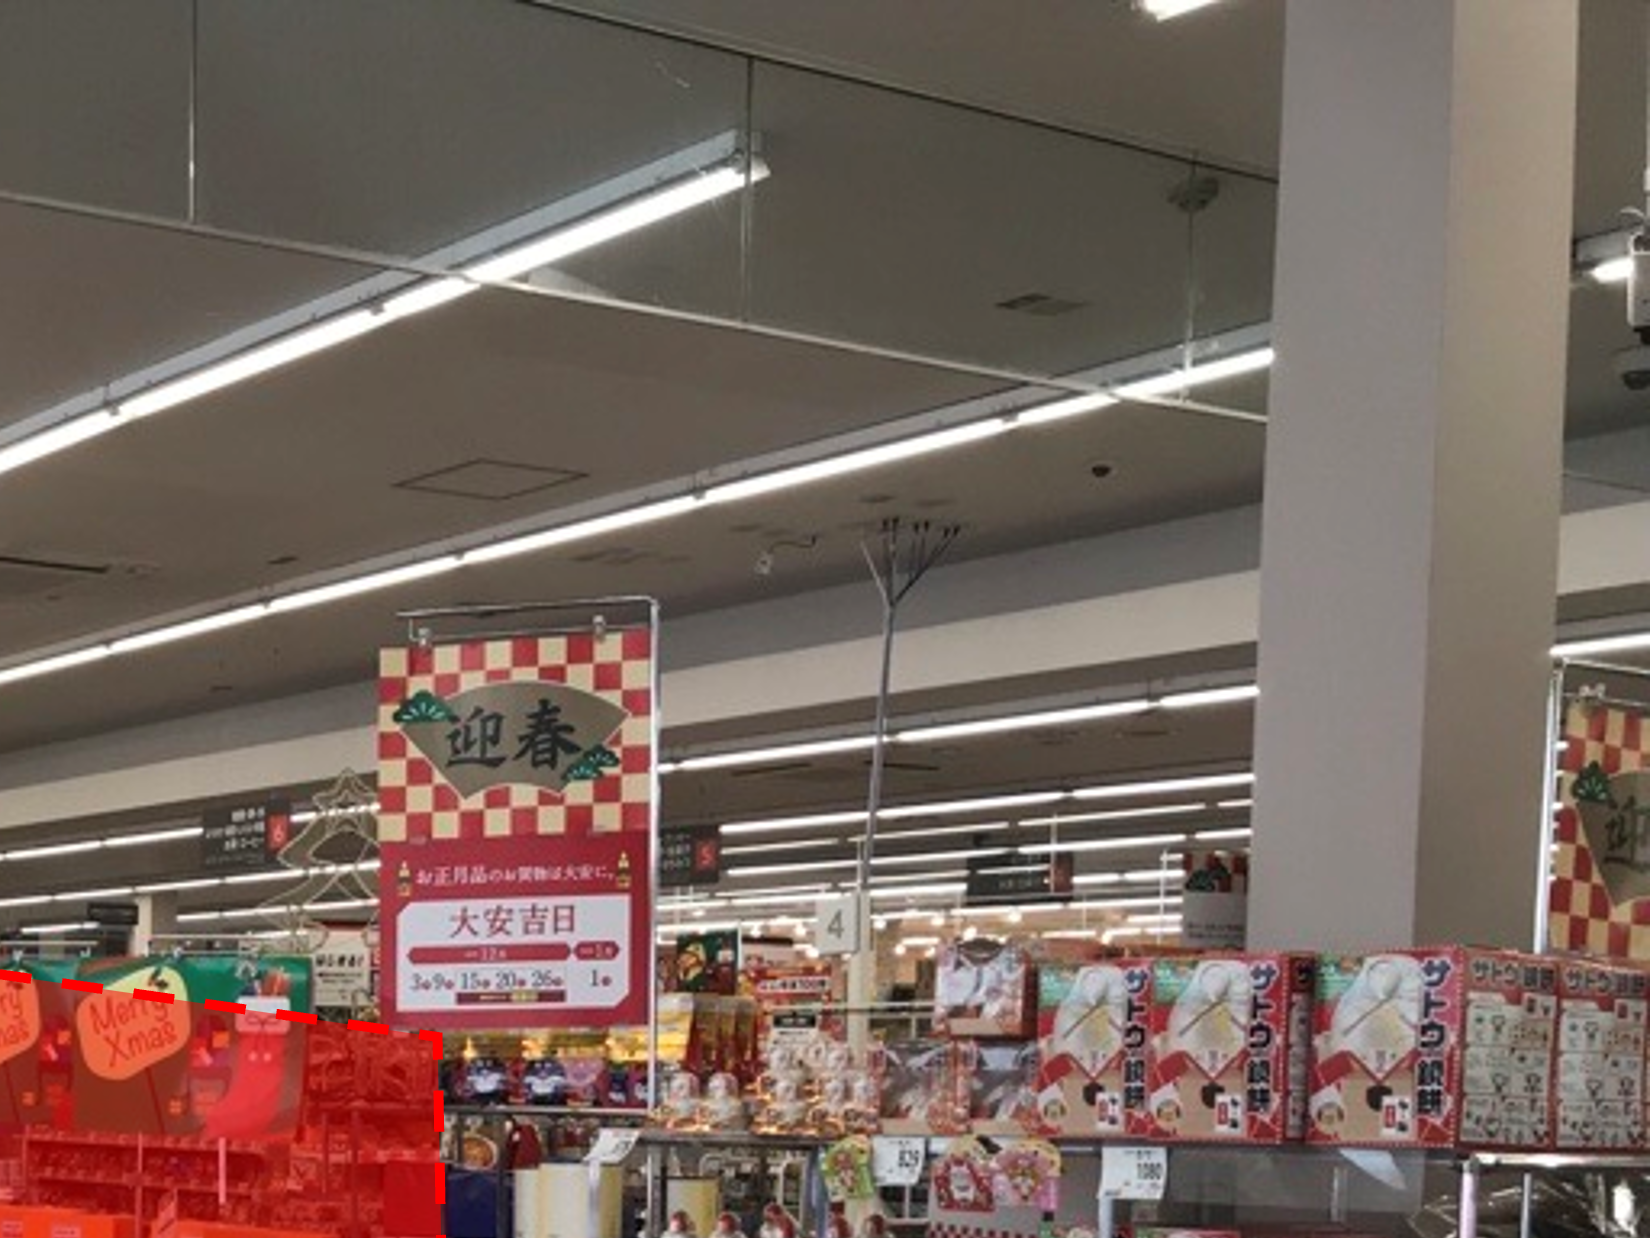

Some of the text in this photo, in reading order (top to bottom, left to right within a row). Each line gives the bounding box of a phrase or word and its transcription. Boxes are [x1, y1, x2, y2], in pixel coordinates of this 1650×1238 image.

[446, 698, 582, 770] 迎春
[450, 905, 576, 939] 大安吉日
[827, 908, 845, 940] 4
[89, 993, 170, 1036] Merry
[103, 1020, 178, 1067] Xmas
